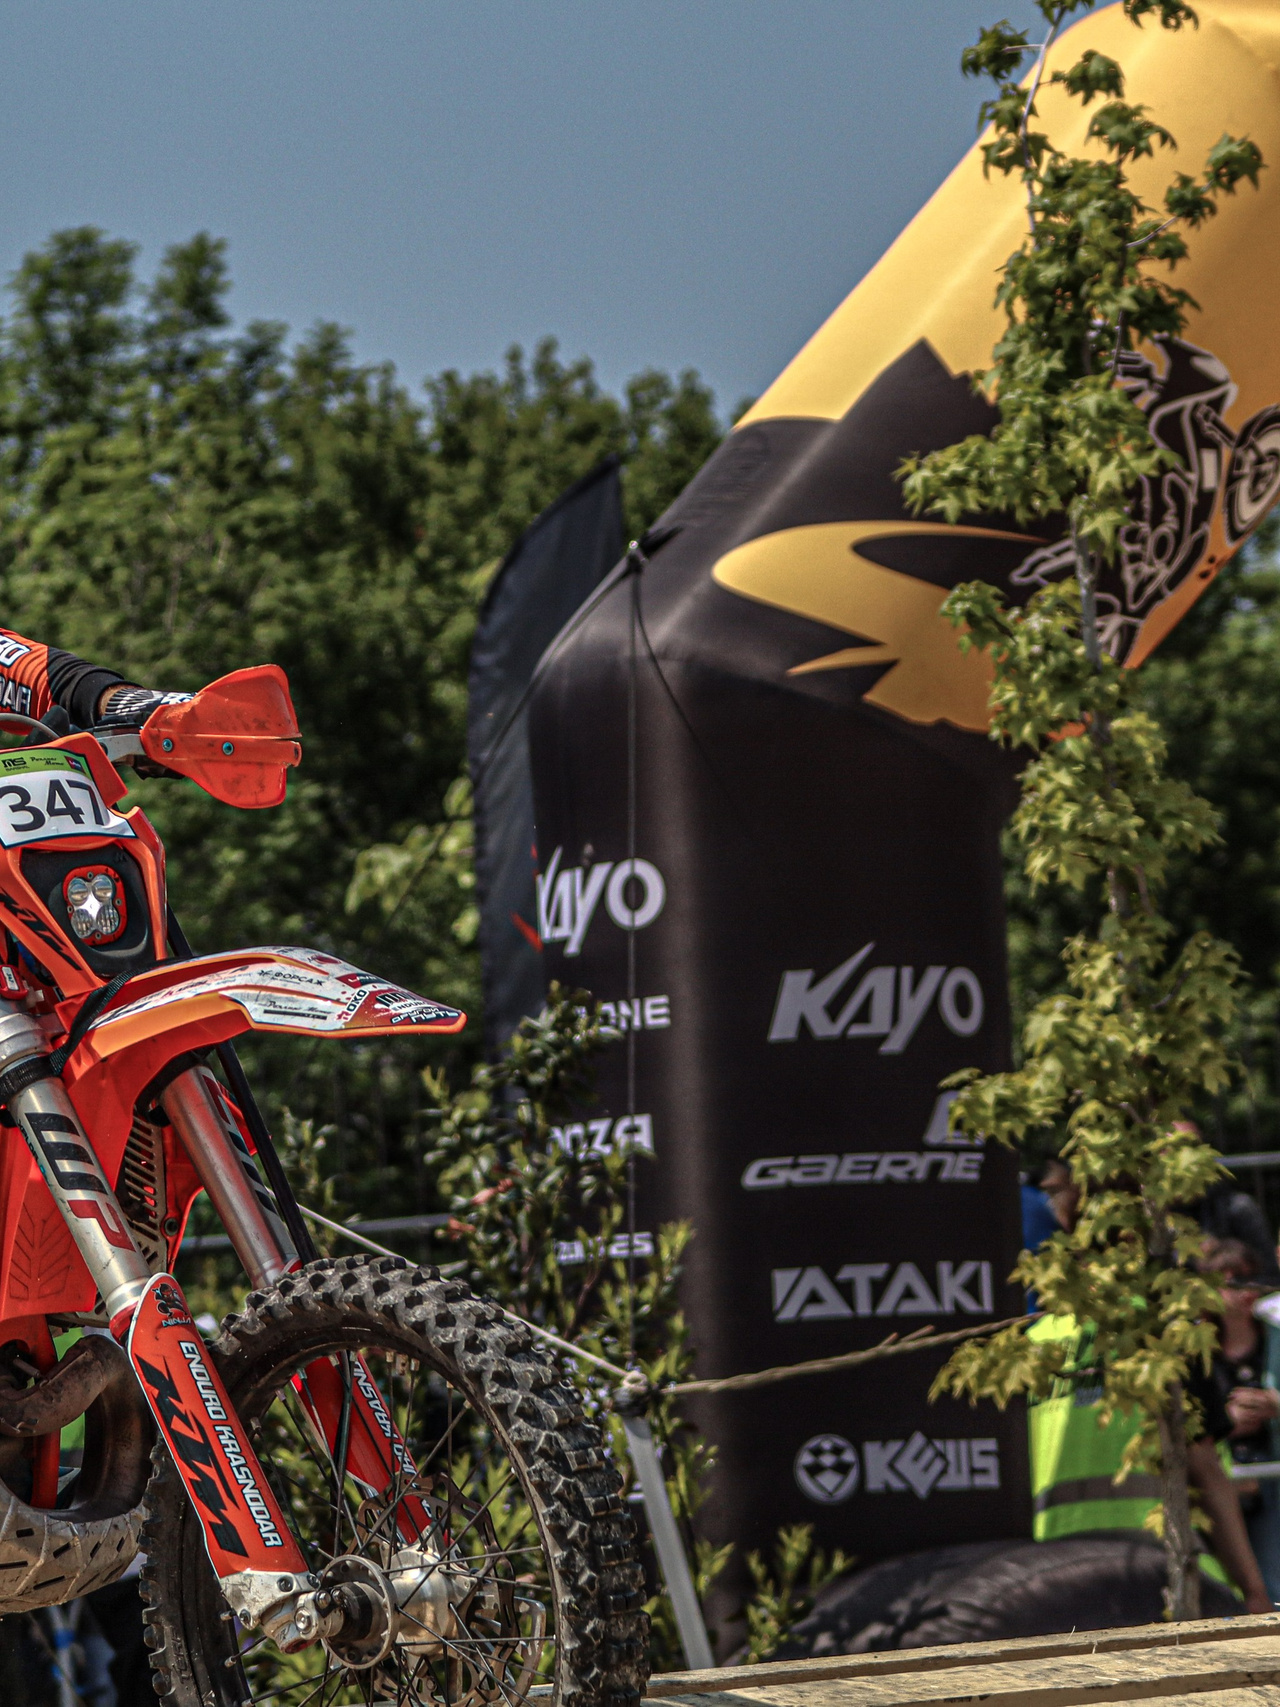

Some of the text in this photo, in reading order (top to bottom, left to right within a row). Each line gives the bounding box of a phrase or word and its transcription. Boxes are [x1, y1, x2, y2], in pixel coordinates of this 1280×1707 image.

[767, 941, 984, 1055] KAYO
[771, 1261, 994, 1322] ATAKI
[179, 1340, 284, 1548] ENDURO KRASNODAR
